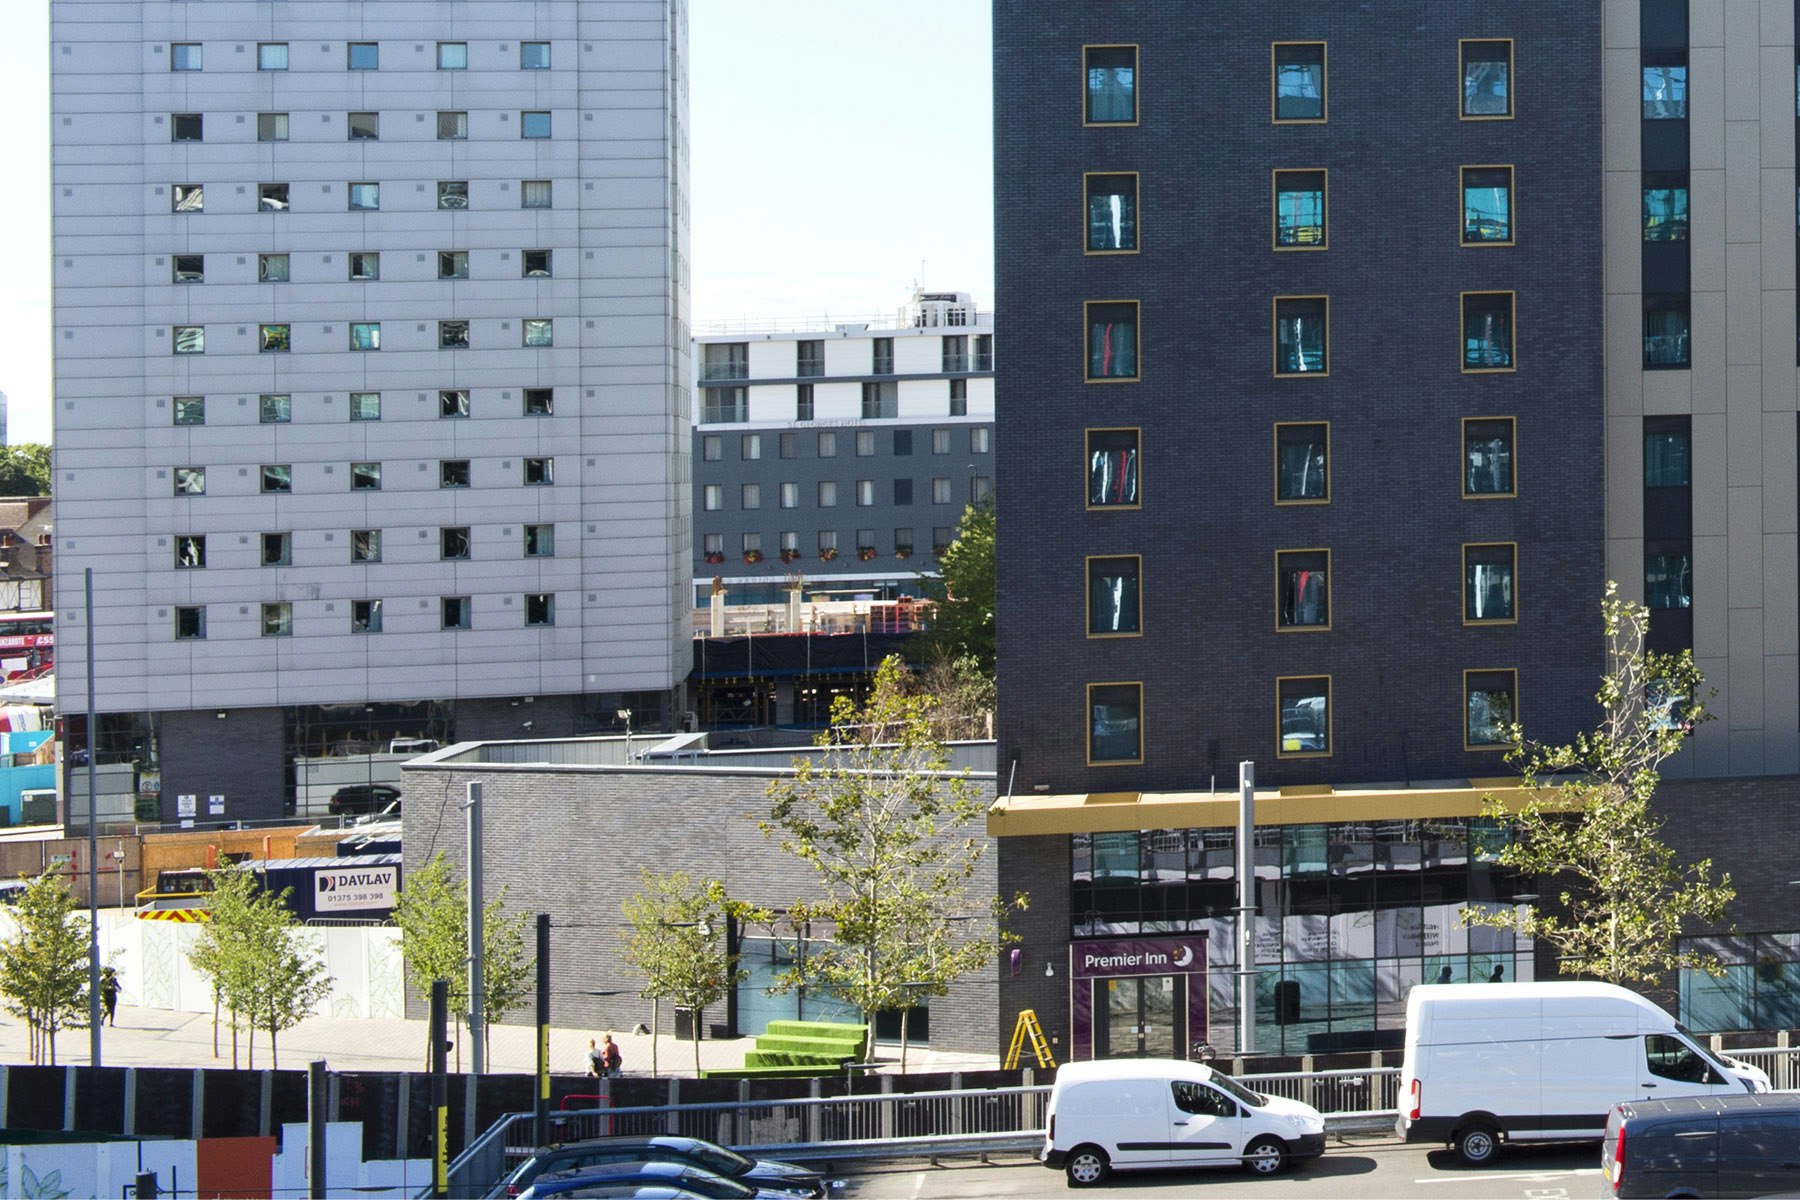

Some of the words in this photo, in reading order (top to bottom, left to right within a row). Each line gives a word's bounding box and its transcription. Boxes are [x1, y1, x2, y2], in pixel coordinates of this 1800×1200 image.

[339, 873, 391, 886] DAVLAV
[1085, 952, 1142, 968] Premier
[1145, 952, 1168, 965] Inn
